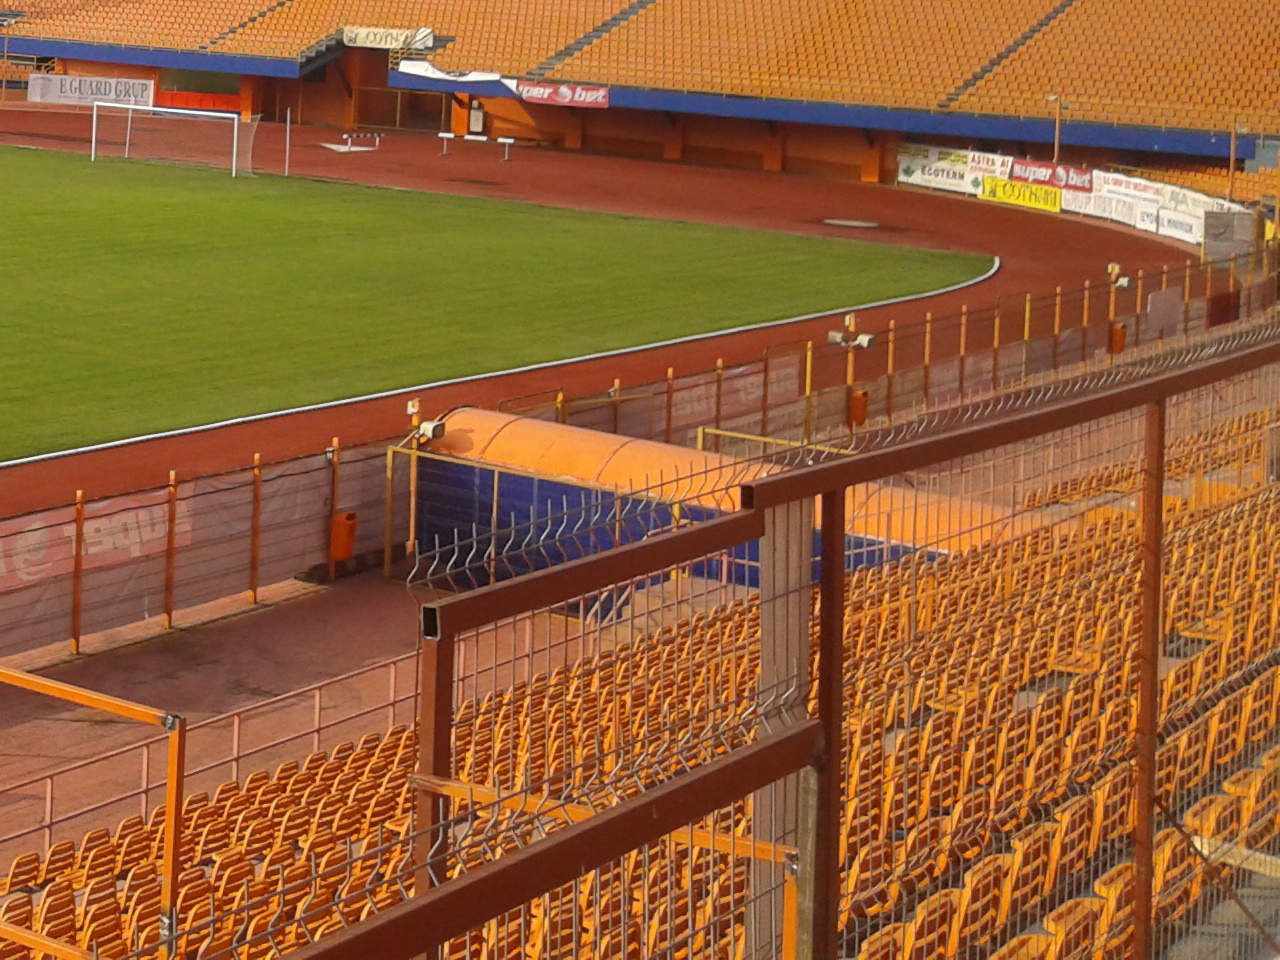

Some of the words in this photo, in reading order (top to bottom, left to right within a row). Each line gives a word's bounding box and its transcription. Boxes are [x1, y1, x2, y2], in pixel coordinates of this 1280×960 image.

[69, 79, 112, 96] GUARD
[114, 80, 149, 99] GRUP
[920, 165, 966, 182] ECOTERM
[1013, 164, 1053, 182] super
[1068, 167, 1092, 188] bet
